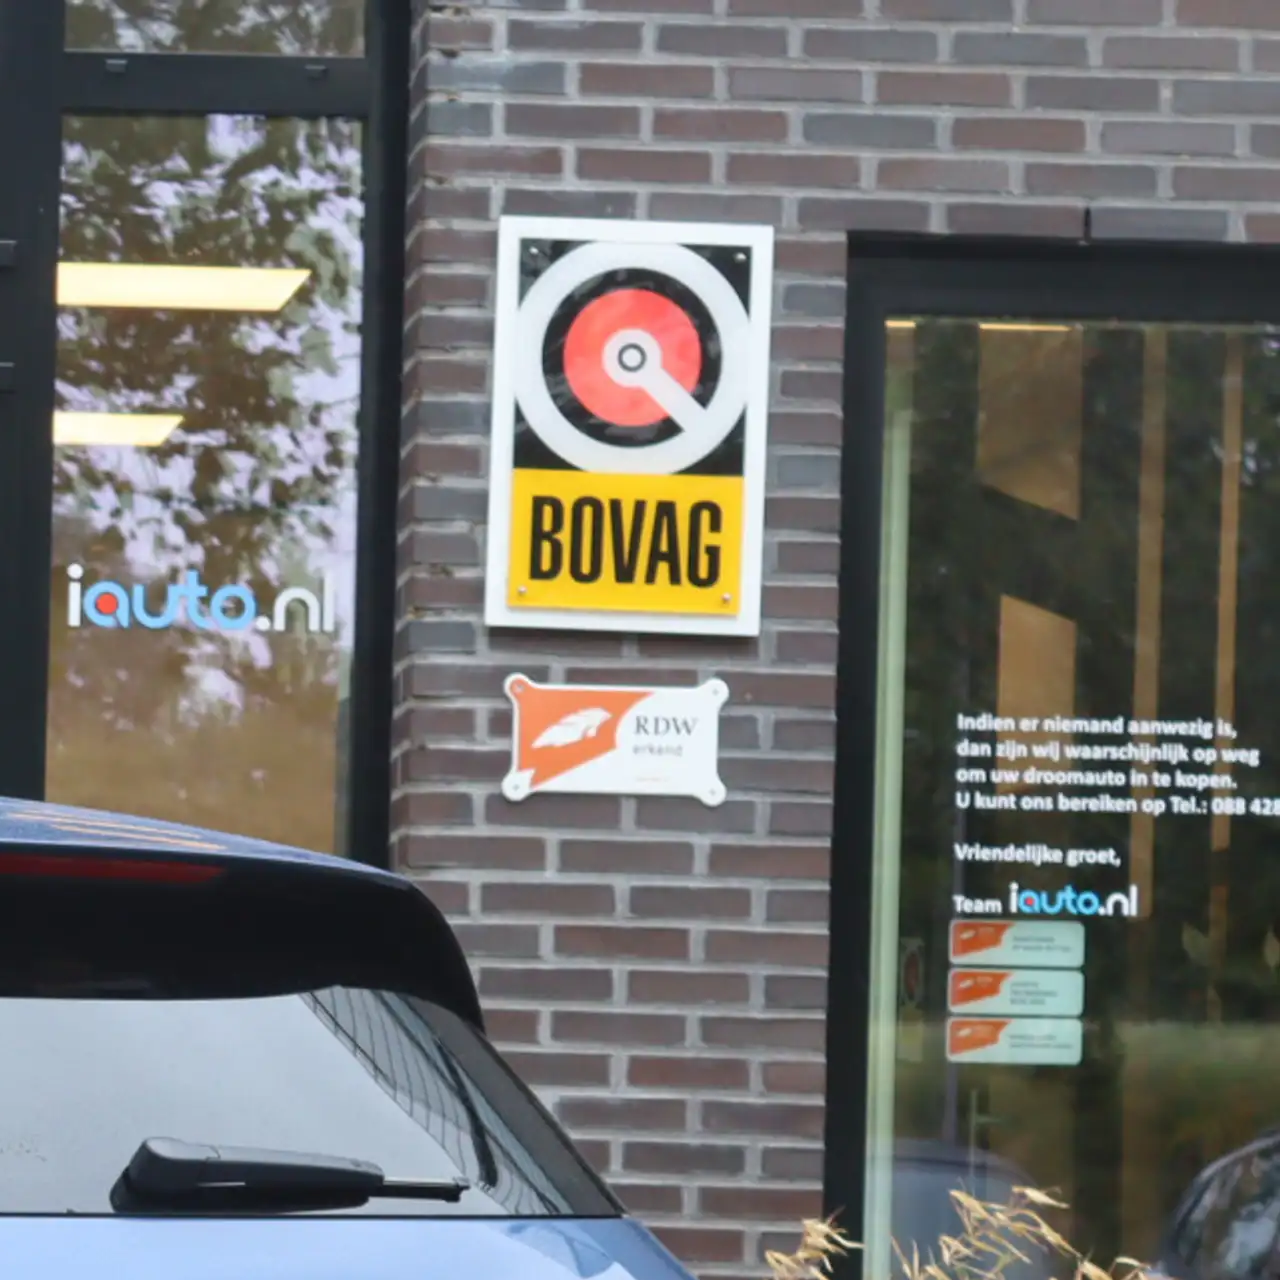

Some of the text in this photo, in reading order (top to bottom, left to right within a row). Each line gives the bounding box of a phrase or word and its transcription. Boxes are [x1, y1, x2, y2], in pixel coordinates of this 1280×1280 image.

[528, 495, 723, 589] BOVAG
[67, 563, 335, 633] iauto.nl
[634, 715, 699, 736] RDW
[957, 713, 1238, 740] Indien er niemand aanwezig is,
[956, 738, 1260, 767] dan zijn wij waarschijnlijk op weg
[956, 766, 1238, 792] om uw droomauto in te kopen.
[956, 791, 971, 809] U
[974, 791, 1017, 810] kunt
[1020, 795, 1054, 811] ons
[1057, 792, 1137, 813] bereiken
[1141, 798, 1166, 817] op
[1169, 795, 1208, 814] Tel.:
[954, 842, 1122, 867] Vriendelijke groet,
[953, 880, 1138, 917] Team iauto.nl
